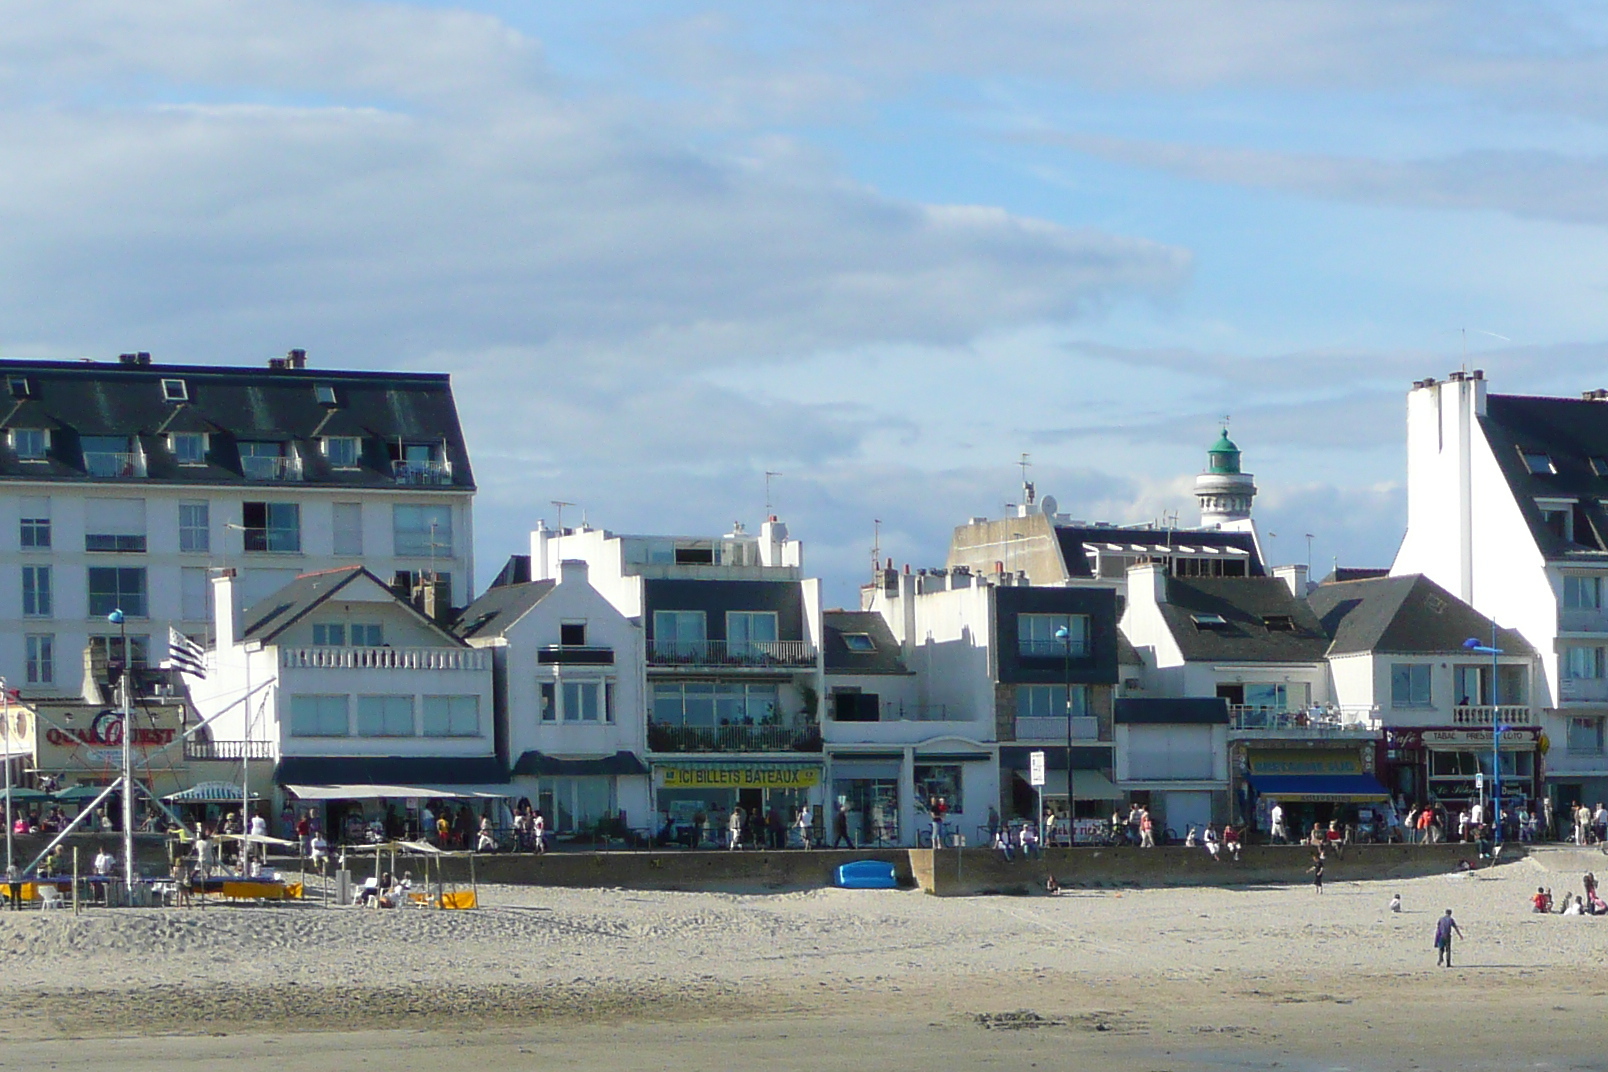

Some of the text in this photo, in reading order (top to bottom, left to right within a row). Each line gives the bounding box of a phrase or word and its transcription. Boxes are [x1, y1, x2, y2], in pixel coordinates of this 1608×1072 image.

[1433, 732, 1457, 740] TABAC
[1503, 732, 1523, 740] LOTO
[679, 769, 800, 784] ICI BILLETS BATEAUX
